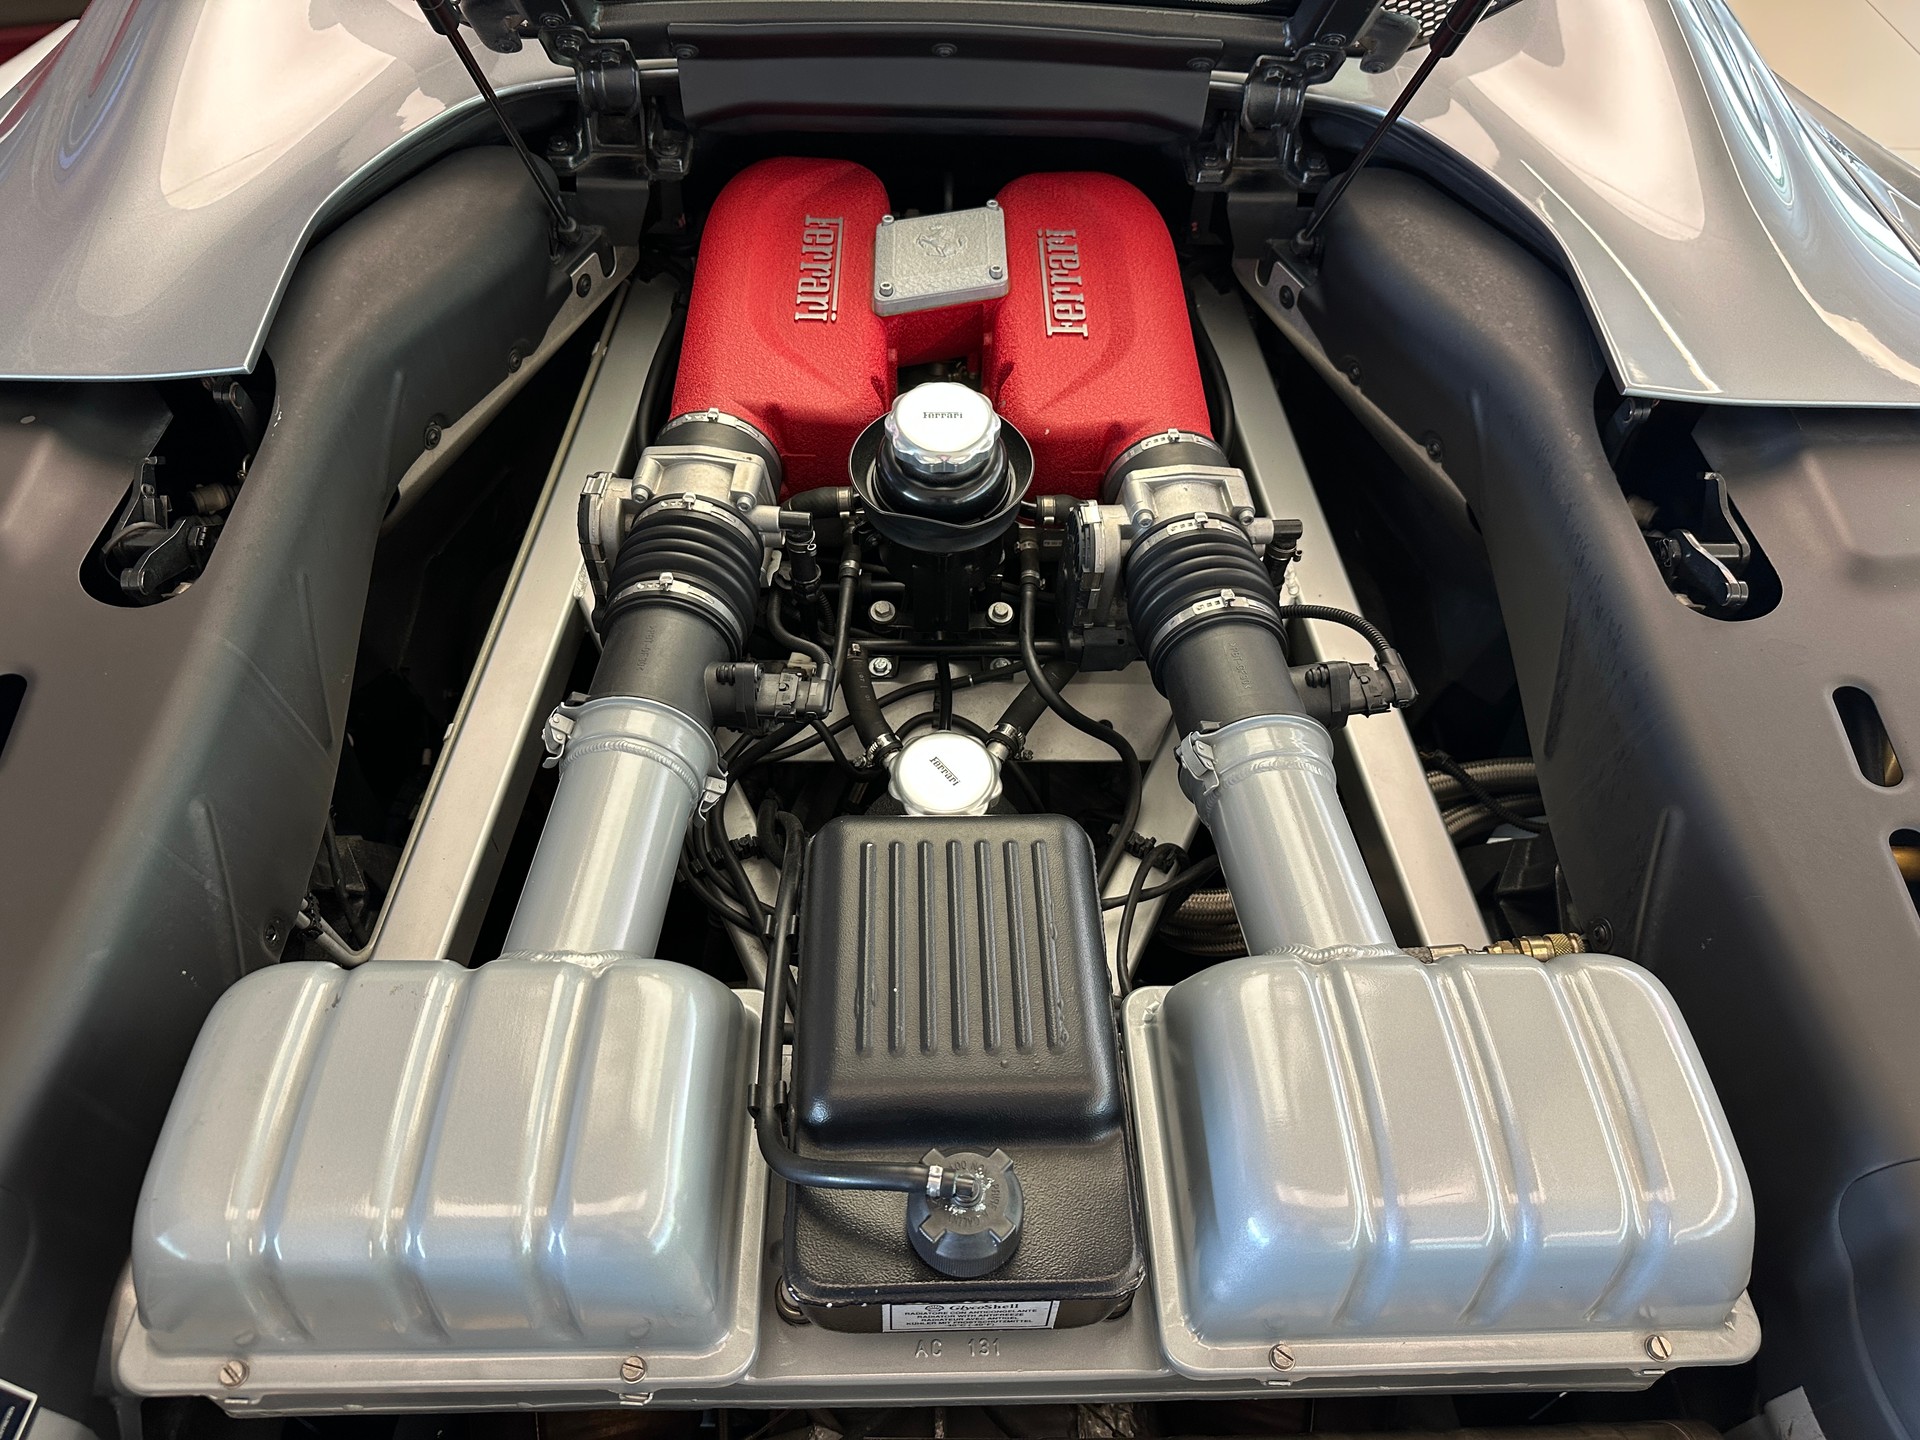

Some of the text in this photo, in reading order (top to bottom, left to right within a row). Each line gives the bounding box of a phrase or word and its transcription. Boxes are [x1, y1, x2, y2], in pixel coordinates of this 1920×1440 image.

[794, 214, 843, 323] Ferrari
[1037, 228, 1089, 339] Ferrari
[923, 411, 963, 419] Ferrari
[928, 756, 961, 786] Ferrari
[915, 1338, 1000, 1358] AC 131
